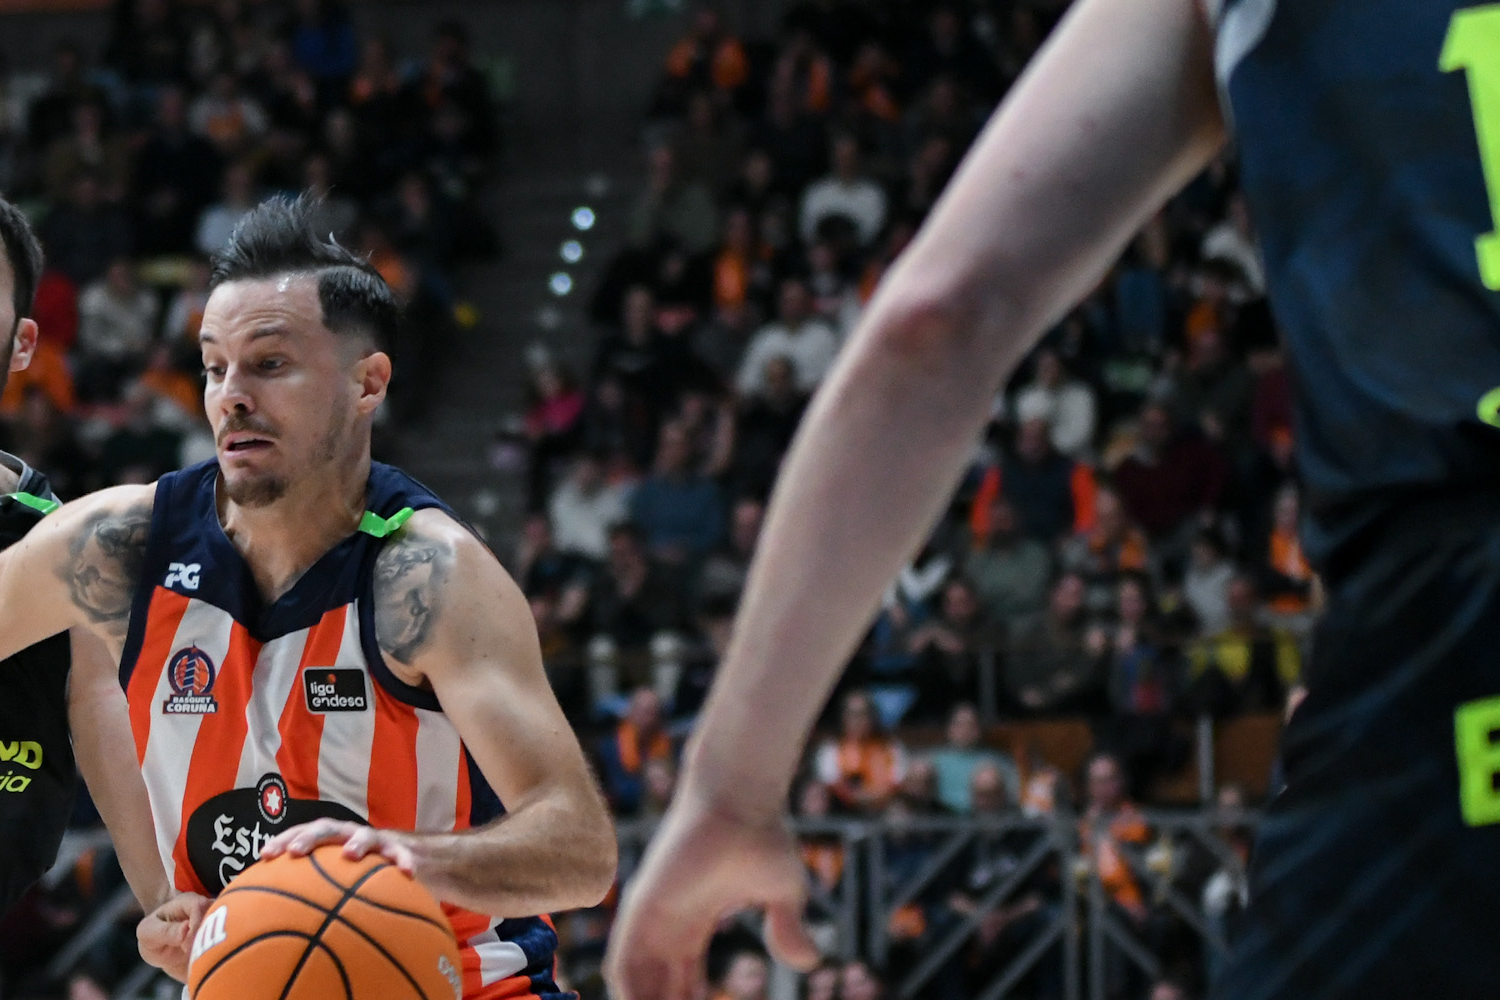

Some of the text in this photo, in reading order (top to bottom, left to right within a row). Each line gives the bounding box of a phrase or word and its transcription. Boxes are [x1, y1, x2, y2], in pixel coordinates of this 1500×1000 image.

[164, 562, 202, 590] PG
[310, 681, 335, 696] liga
[172, 696, 212, 704] BASQUET
[312, 694, 365, 708] endesa
